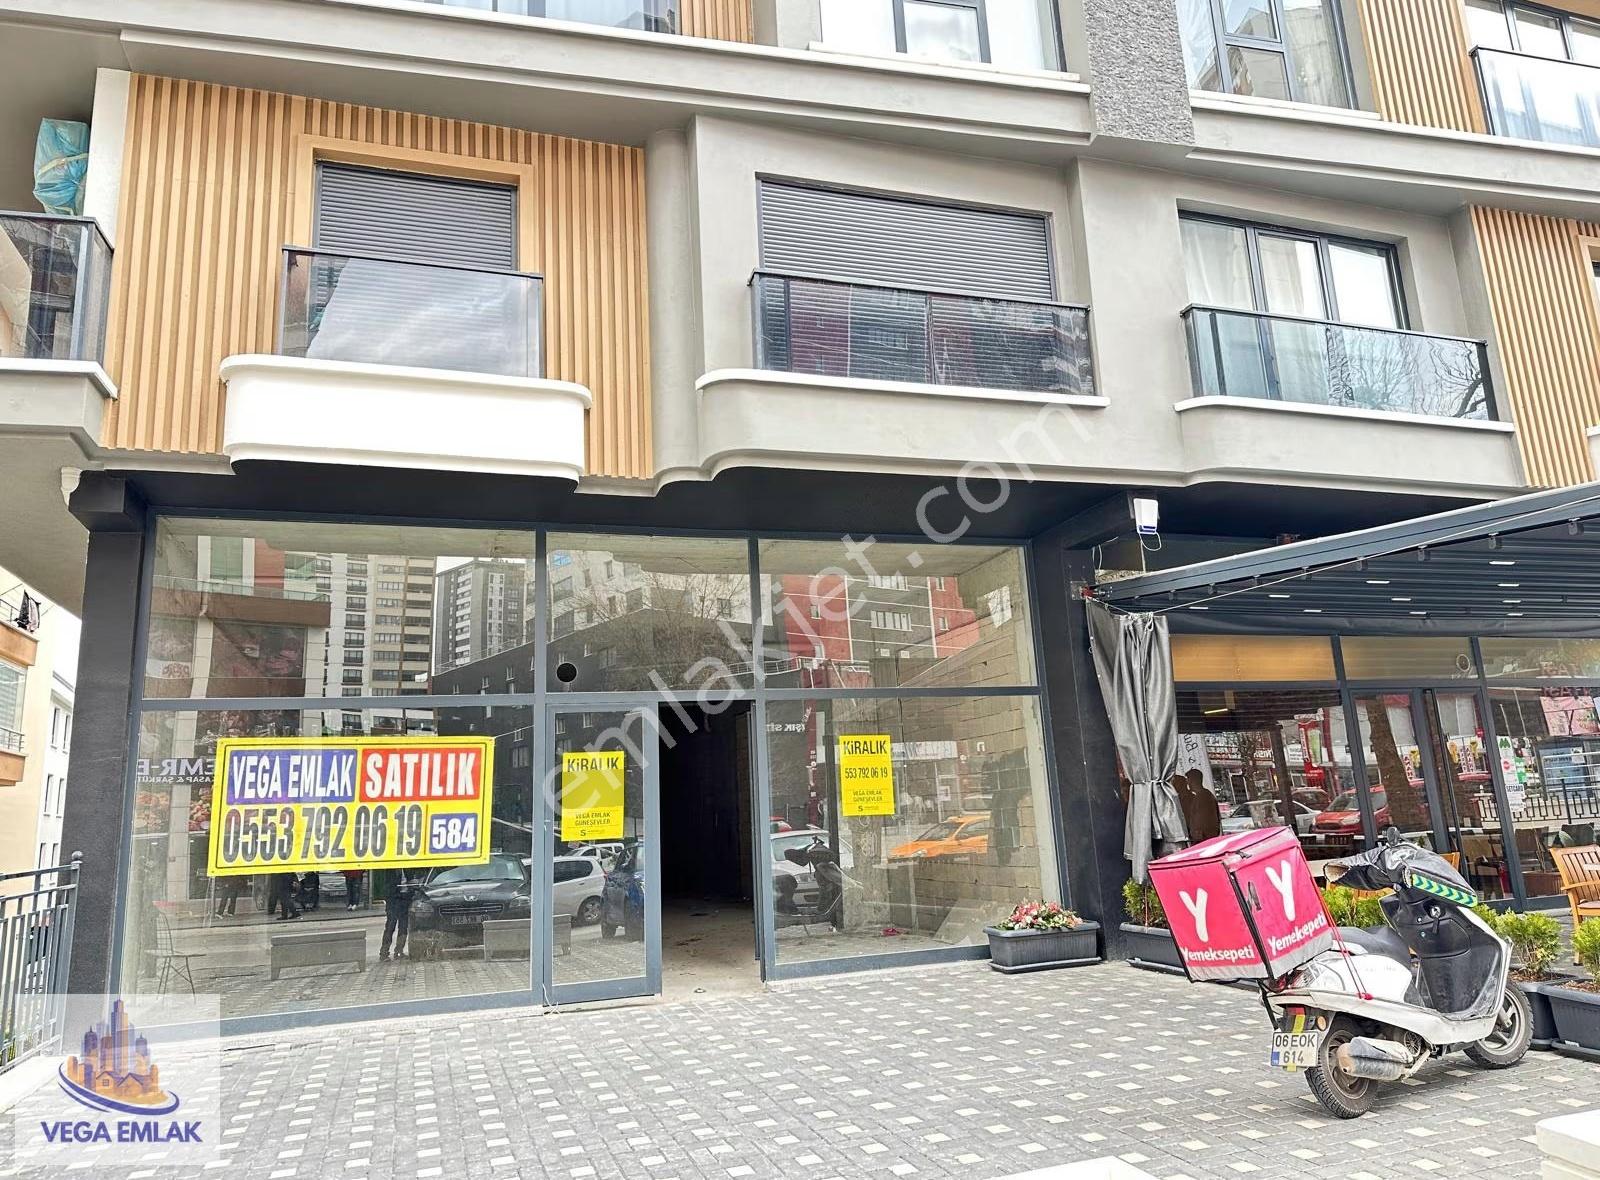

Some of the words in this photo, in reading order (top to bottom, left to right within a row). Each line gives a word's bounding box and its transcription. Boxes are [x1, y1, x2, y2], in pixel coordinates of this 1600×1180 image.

[233, 755, 282, 798] VEGA
[288, 754, 354, 797] EMLAK
[365, 752, 476, 798] SATILIK
[845, 767, 857, 779] 553
[858, 767, 870, 778] 792
[870, 767, 879, 778] 06
[880, 767, 888, 778] 19
[222, 805, 295, 864] 0553
[301, 804, 348, 861] 792
[353, 804, 388, 859] 06
[394, 803, 423, 858] 19
[432, 816, 476, 850] 584
[1268, 911, 1328, 956] Yemeksepeti
[1180, 944, 1255, 963] Yemeksepeti
[1275, 1034, 1289, 1047] 06
[1290, 1034, 1316, 1047] EOK
[1283, 1050, 1304, 1064] 614
